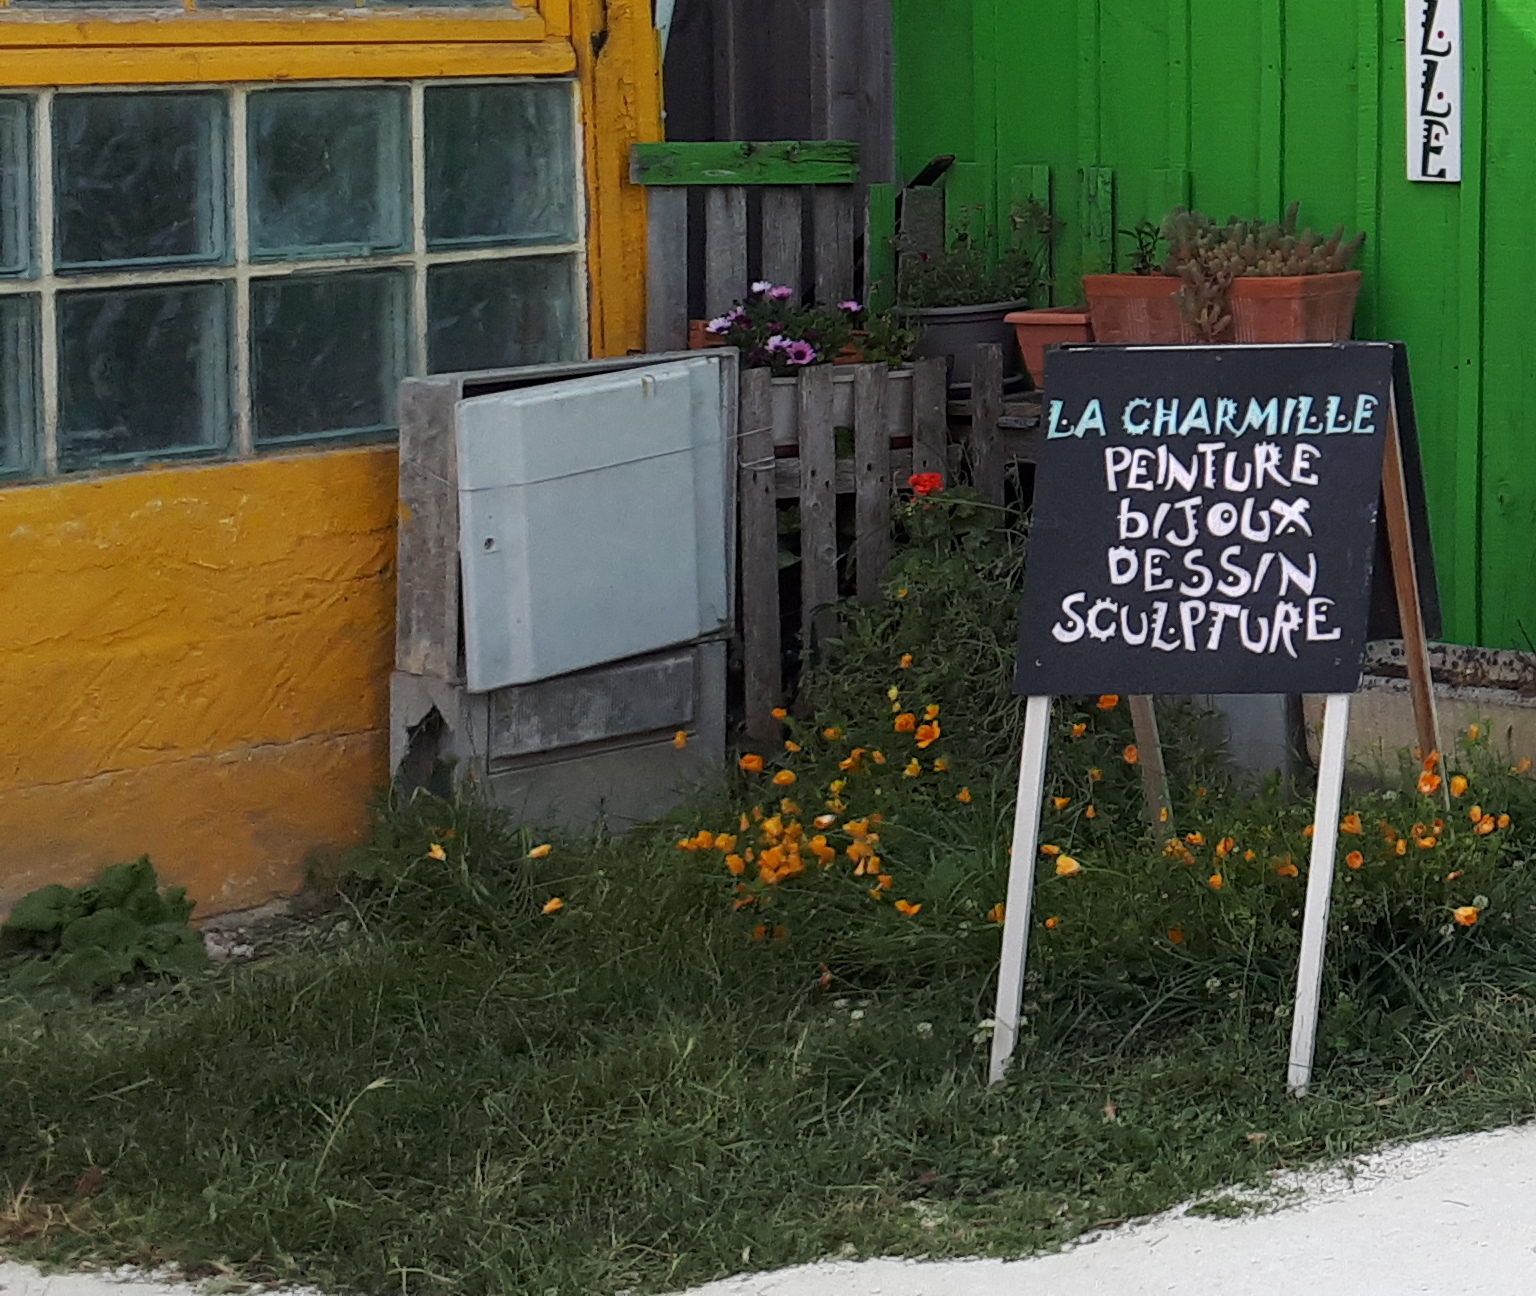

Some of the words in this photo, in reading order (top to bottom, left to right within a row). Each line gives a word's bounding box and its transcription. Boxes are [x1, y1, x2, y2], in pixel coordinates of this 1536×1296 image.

[1046, 399, 1107, 440] LA
[1121, 394, 1379, 438] CHARMILLE
[1104, 441, 1322, 493] PEINTURE
[1107, 544, 1317, 599] DESSIN
[1051, 591, 1342, 659] SCULPTURE
